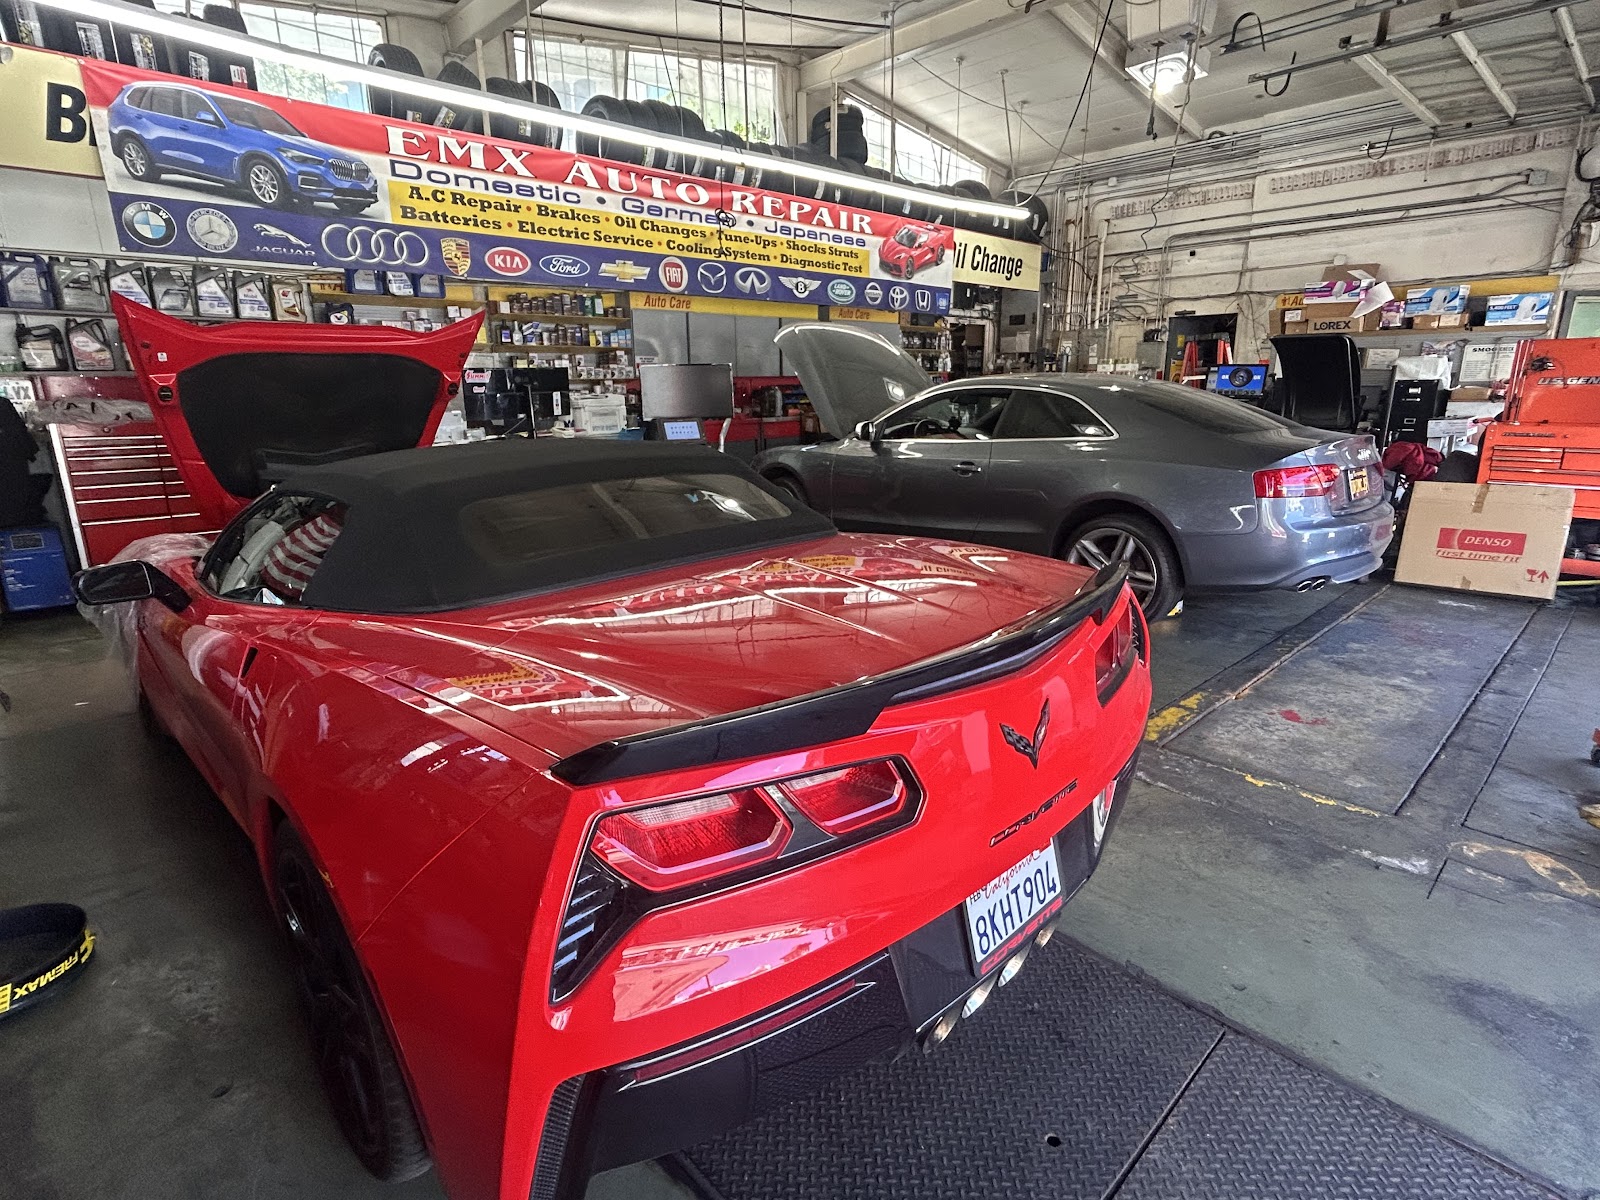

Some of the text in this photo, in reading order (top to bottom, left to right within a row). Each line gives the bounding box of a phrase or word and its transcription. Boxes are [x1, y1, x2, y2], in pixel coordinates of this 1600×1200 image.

[386, 124, 874, 235] EMX AUTO REPAIR
[127, 203, 169, 219] BMW
[389, 159, 581, 205] Domestic
[765, 220, 866, 248] Japanese
[409, 186, 859, 259] A.C Repair Brakes Oil Changes Tune-Ups Shocks Struts
[252, 245, 316, 257] JAGUAR
[400, 205, 863, 273] Batteries Electric Service Cooling System Diagnostic Test
[494, 253, 526, 269] KIA
[549, 257, 581, 274] Ford
[664, 266, 682, 283] FIAT
[970, 244, 1023, 282] Change
[643, 294, 691, 310] Auto Care
[1313, 320, 1351, 331] LOREX
[1464, 536, 1511, 547] DENSO
[1468, 552, 1501, 561] time
[1503, 555, 1522, 563] fit
[989, 778, 1078, 848] CORVETTE
[975, 860, 1057, 955] 8KHT904
[980, 896, 1063, 975] CORVETTE
[13, 951, 78, 1000] FREMAX
